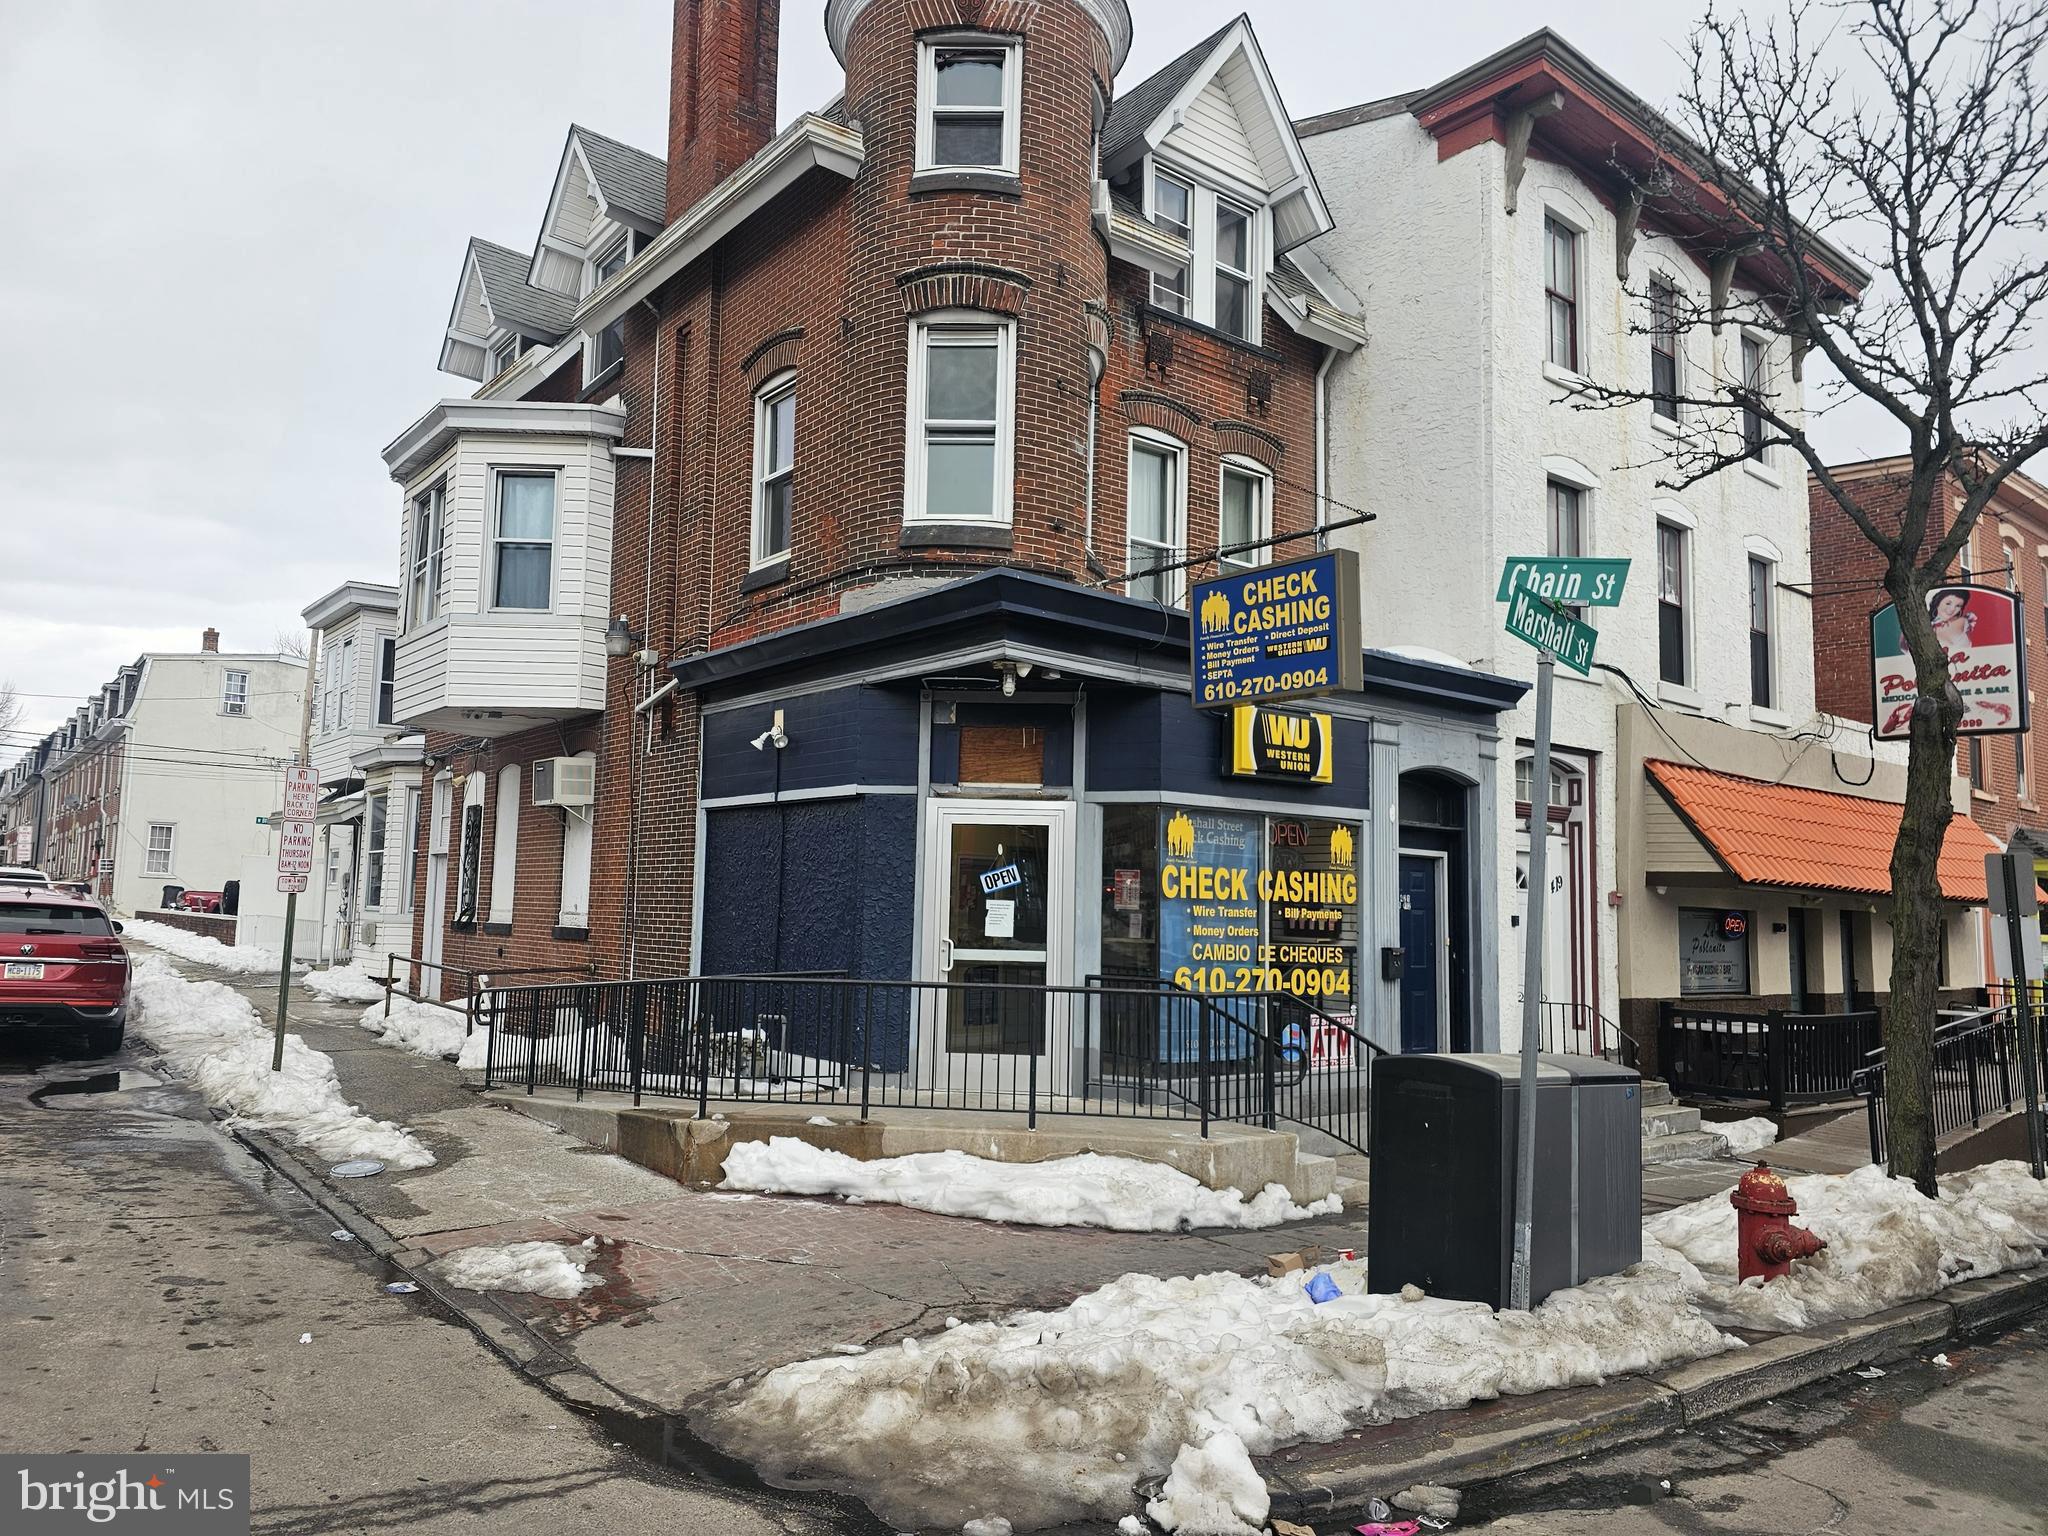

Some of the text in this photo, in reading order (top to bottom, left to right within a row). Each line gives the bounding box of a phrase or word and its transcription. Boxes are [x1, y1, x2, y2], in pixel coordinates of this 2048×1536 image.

[1243, 568, 1318, 606] CHECK
[1508, 563, 1616, 600] Chain St
[1233, 595, 1330, 634] CASHING
[1270, 622, 1329, 640] Direct Deposit
[1512, 592, 1589, 667] Marshall St
[1206, 636, 1258, 650] Wire Transfer
[1266, 641, 1303, 653] WESTERN
[1206, 646, 1260, 660] Money Orders
[1277, 648, 1303, 657] UNION
[1207, 655, 1256, 670] Bill Payment
[1207, 669, 1234, 680] SEPTA
[1204, 667, 1328, 701] 610-270-0904
[1975, 688, 1983, 696] &
[1986, 686, 2010, 694] BAR
[1264, 713, 1310, 749] WU
[1266, 748, 1310, 762] WESTERN
[1280, 760, 1310, 772] UNION
[297, 770, 308, 780] NO
[288, 781, 316, 794] PARKING
[292, 793, 309, 801] HERE
[286, 801, 315, 810] BACK TO
[287, 809, 313, 817] CORNER
[293, 823, 304, 834] NO
[1217, 819, 1244, 832] Street
[284, 836, 312, 847] PARKING
[1206, 832, 1246, 850] Cashing
[1269, 823, 1308, 846] OPEN
[281, 849, 310, 858] THURSDAY
[281, 860, 309, 869] 8AM-12 NOON
[984, 868, 1017, 890] OPEN
[1161, 864, 1249, 901] CHECK
[1257, 869, 1357, 904] CASHING
[1193, 905, 1257, 919] Wire Transfer
[1285, 907, 1342, 922] Bill Payments
[1193, 924, 1259, 939] Money Orders
[1725, 918, 1746, 933] OPEN
[1191, 943, 1343, 964] CAMBIO DE CHEQUES
[1174, 967, 1350, 996] 610-270-0904
